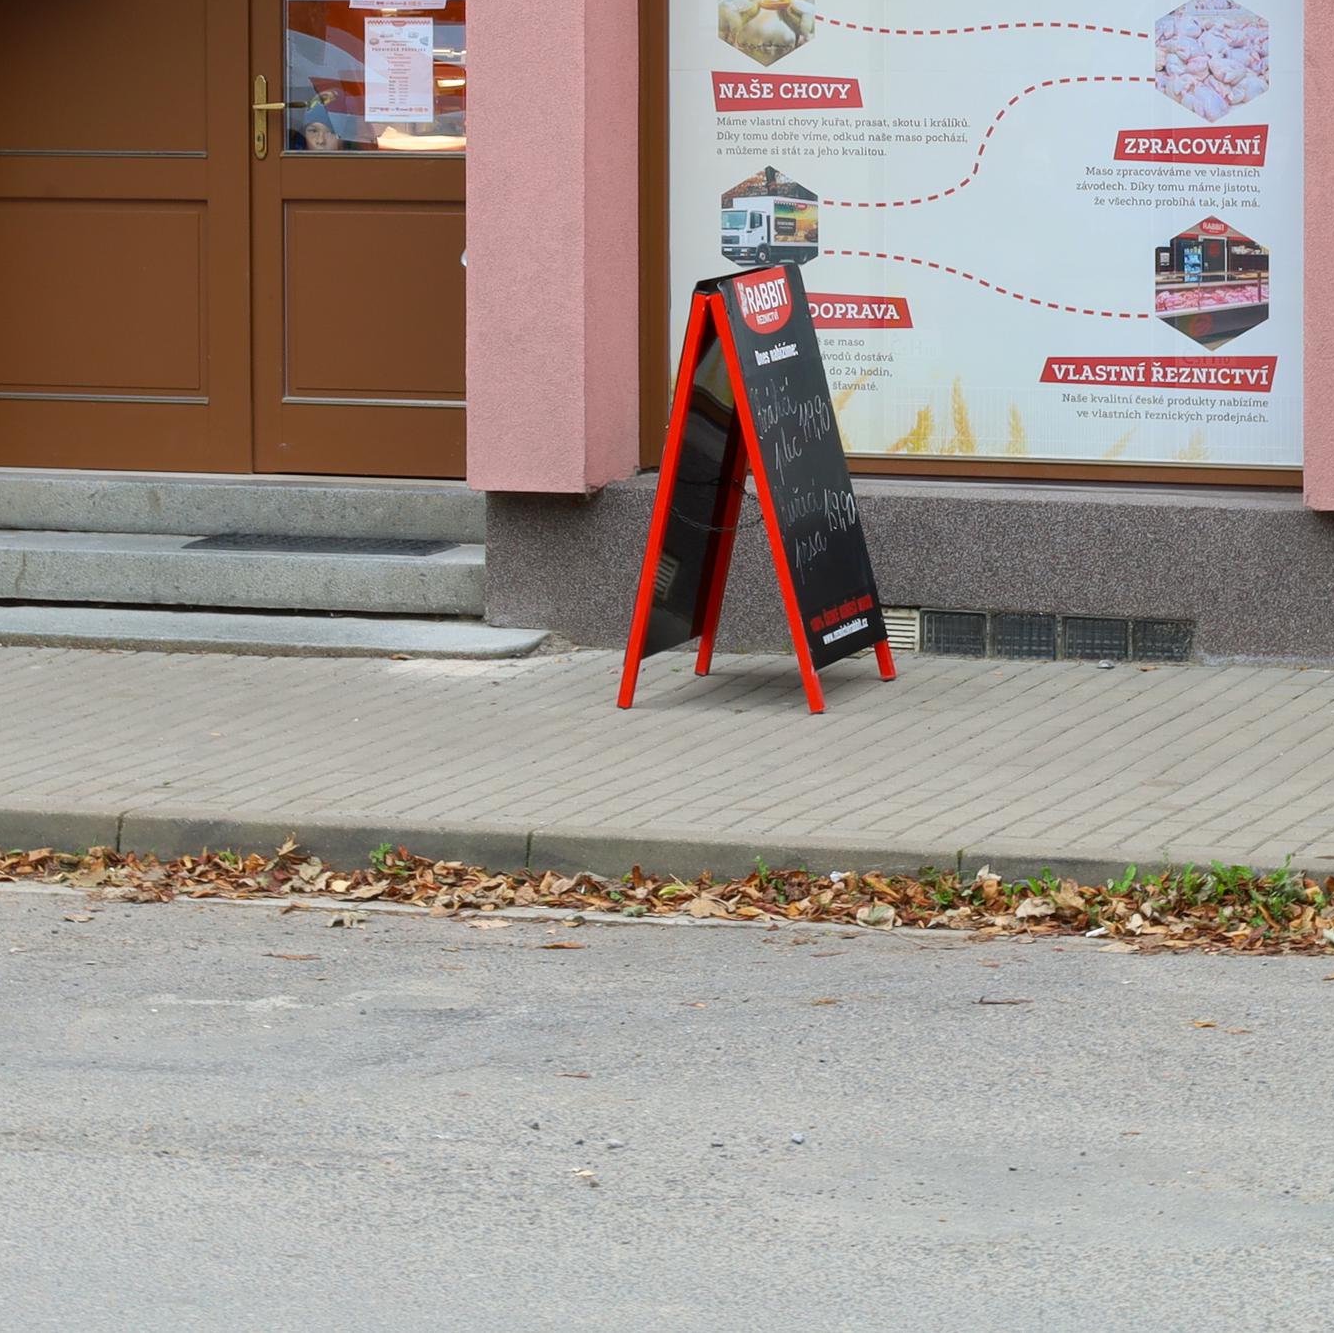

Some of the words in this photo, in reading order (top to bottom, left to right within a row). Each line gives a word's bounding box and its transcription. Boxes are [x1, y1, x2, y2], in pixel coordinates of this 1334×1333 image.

[719, 79, 774, 99] NAŠE
[779, 83, 851, 99] CHOVY
[717, 117, 747, 126] Máme
[750, 117, 786, 126] vlastní
[788, 117, 818, 128] chovy
[821, 118, 852, 128] kuřat,
[855, 119, 890, 128] prasat,
[892, 118, 921, 127] skotu
[930, 118, 970, 128] králíků.
[717, 132, 740, 143] Díky
[742, 133, 768, 141] tomu
[771, 131, 799, 141] dobře
[802, 132, 831, 142] víme,
[833, 132, 865, 142] odkud
[868, 133, 892, 142] naše
[925, 133, 968, 144] pochází,
[1124, 135, 1261, 155] ZPRACOVÁNÍ
[725, 146, 768, 155] můžeme
[770, 146, 779, 155] si
[782, 147, 801, 156] stát
[817, 147, 839, 158] jeho
[842, 147, 886, 156] kvalitou.
[1086, 167, 1113, 176] Maso
[1116, 167, 1191, 181] zpracováváme
[1195, 169, 1207, 177] ve
[1210, 168, 1260, 177] vlastních
[1076, 181, 1127, 191] závodech.
[1130, 182, 1154, 193] Díky
[1158, 183, 1185, 192] tomu
[1188, 182, 1221, 192] máme
[1223, 182, 1260, 194] jistotu,
[1094, 196, 1105, 206] že
[1108, 196, 1152, 206] všechno
[1155, 196, 1196, 208] probíhá
[1199, 197, 1218, 208] tak,
[1221, 197, 1237, 208] jak
[1241, 198, 1260, 208] má.
[745, 278, 788, 315] RABBIT
[809, 302, 900, 320] DOPRAVA
[838, 339, 865, 347] maso
[821, 352, 851, 362] ávodů
[854, 352, 894, 362] dostává
[829, 367, 842, 376] do
[845, 368, 857, 376] 24
[860, 367, 893, 377] hodin,
[1052, 362, 1145, 382] VLASTNÍ
[1151, 362, 1269, 385] ŘEZNICTVÍ
[1062, 394, 1088, 403] Naše
[1090, 394, 1133, 404] kvalitní
[1135, 395, 1164, 405] české
[1167, 396, 1217, 408] produkty
[1219, 397, 1269, 408] nabízíme
[1092, 408, 1141, 419] vlastních
[1145, 410, 1203, 422] řeznických
[1206, 412, 1269, 424] prodejnách.
